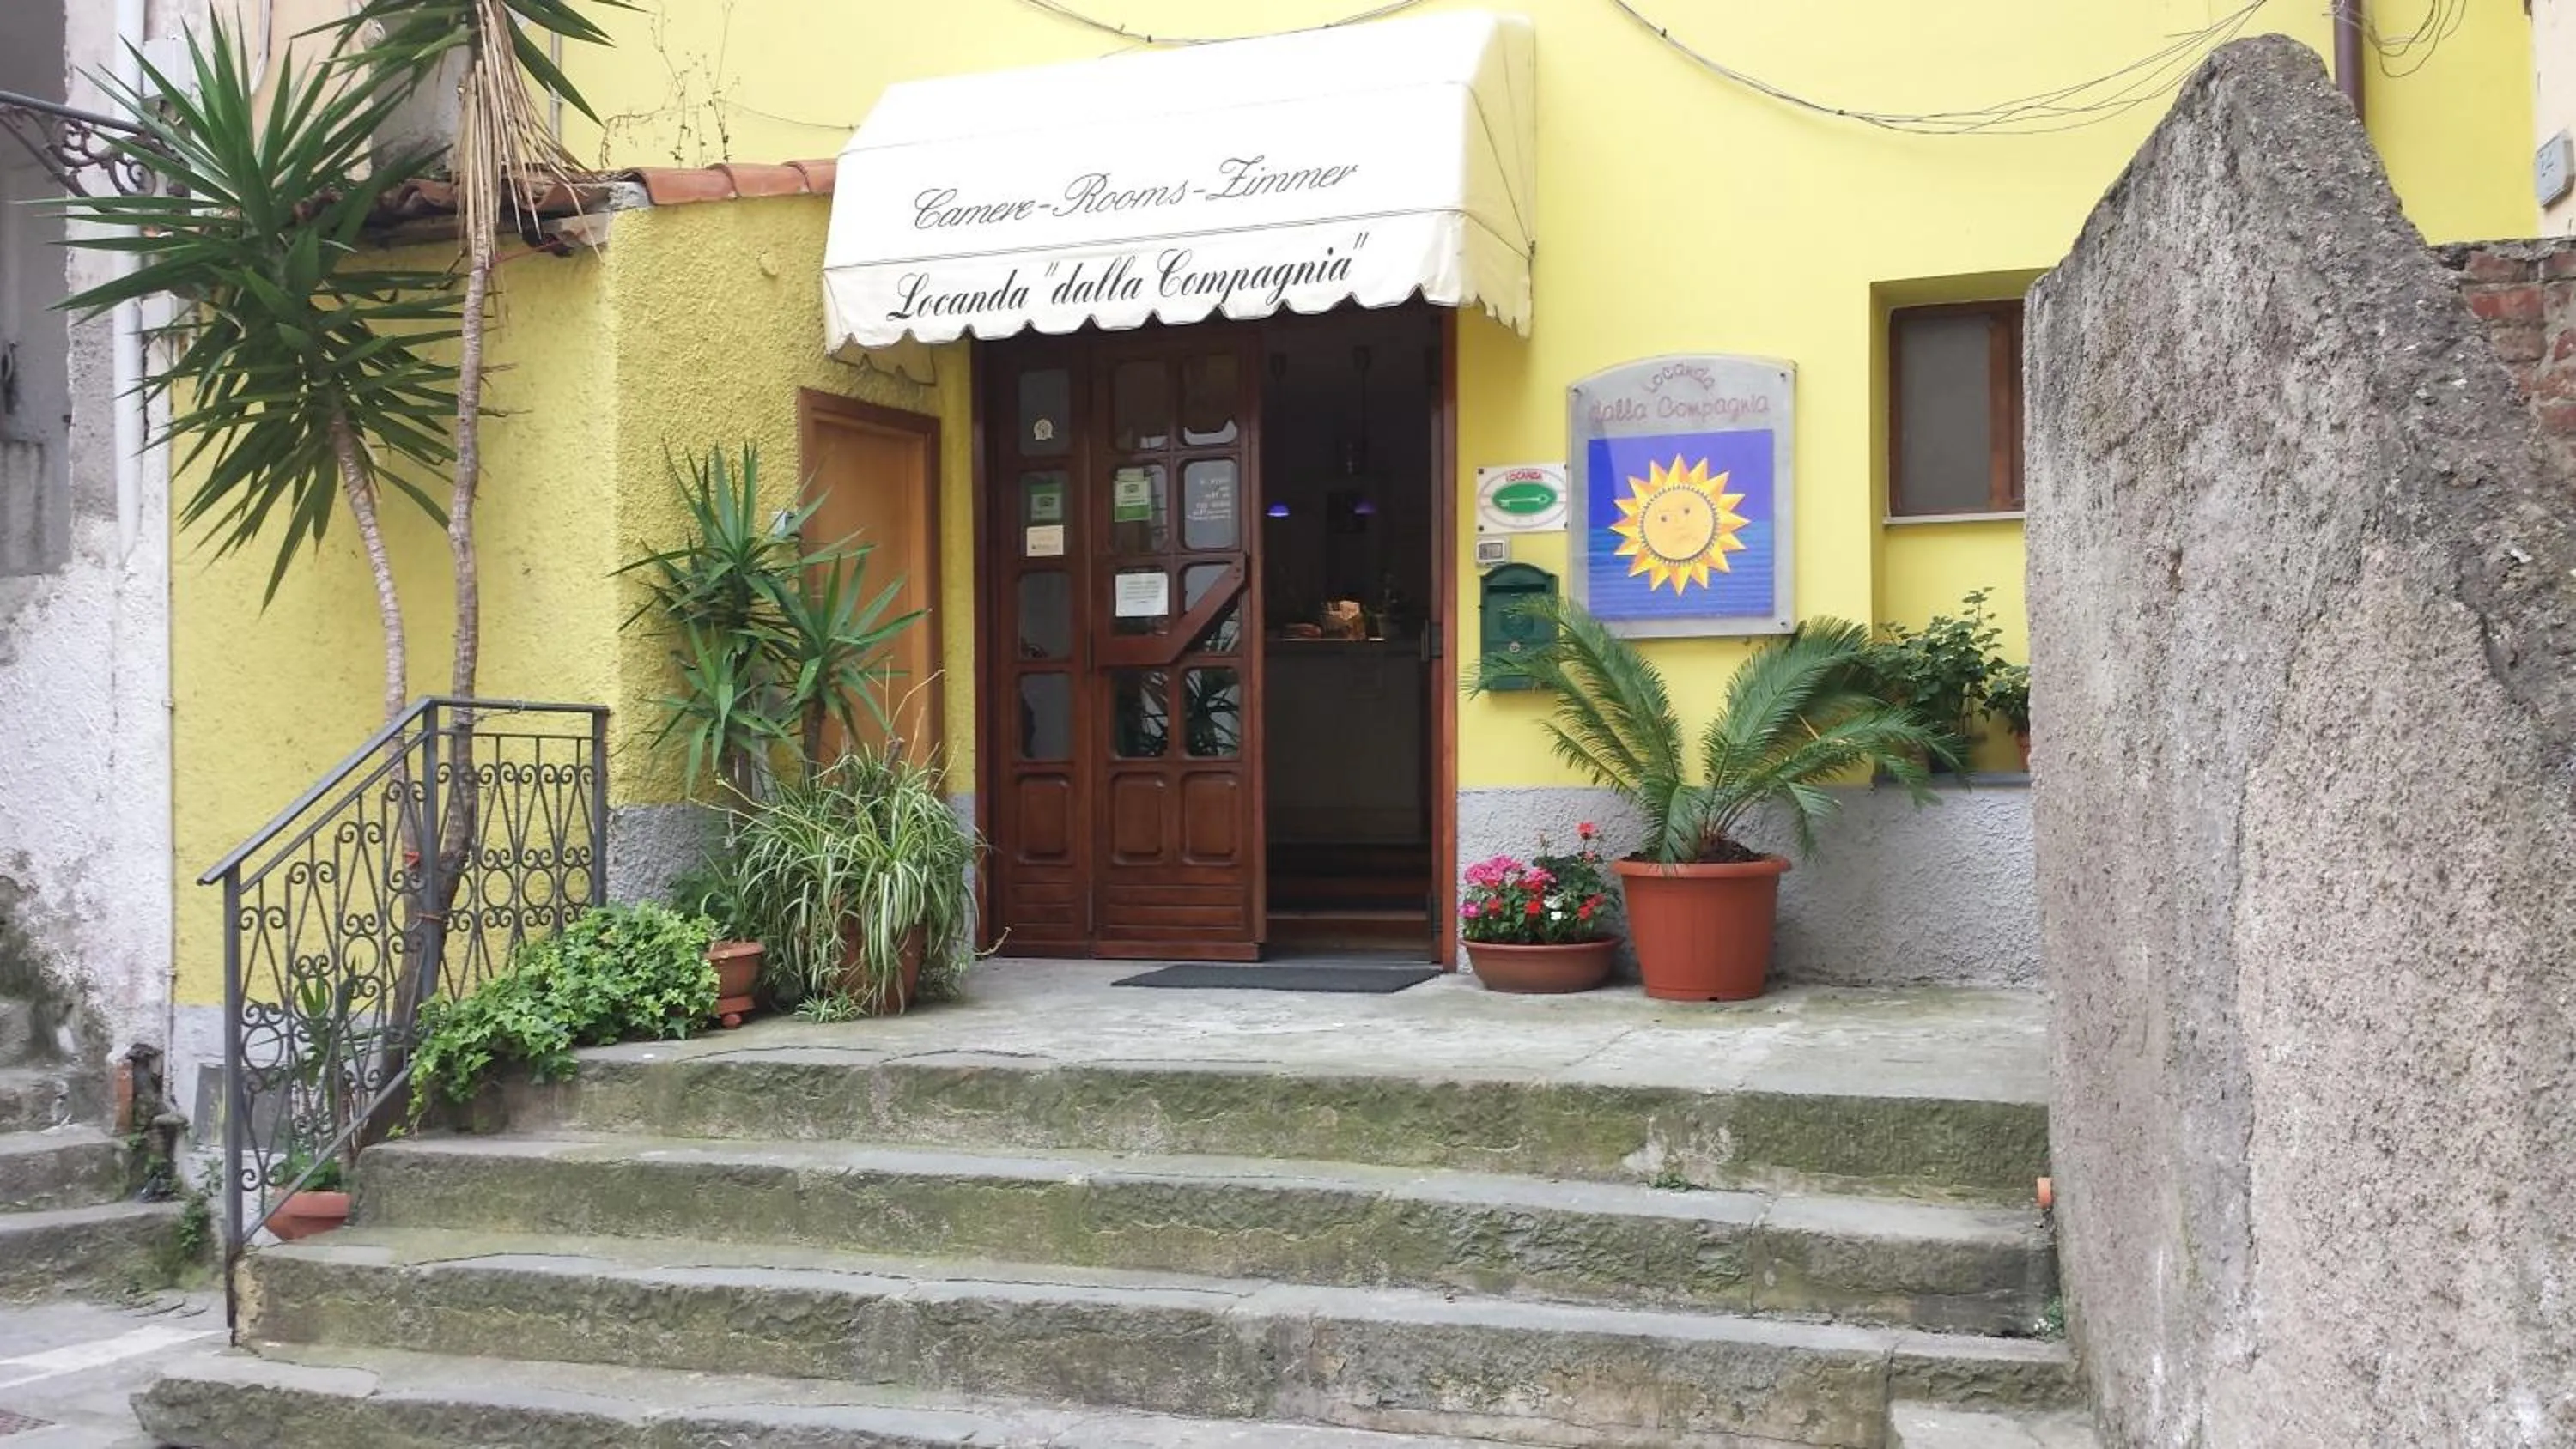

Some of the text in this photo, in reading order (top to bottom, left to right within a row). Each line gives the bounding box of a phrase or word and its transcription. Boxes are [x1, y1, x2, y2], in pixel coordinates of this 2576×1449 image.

[886, 269, 1030, 321] Locanda
[1643, 362, 1716, 393] Locanda
[1589, 395, 1771, 423] dalla Compagnia
[1505, 470, 1544, 482] LOCANDA
